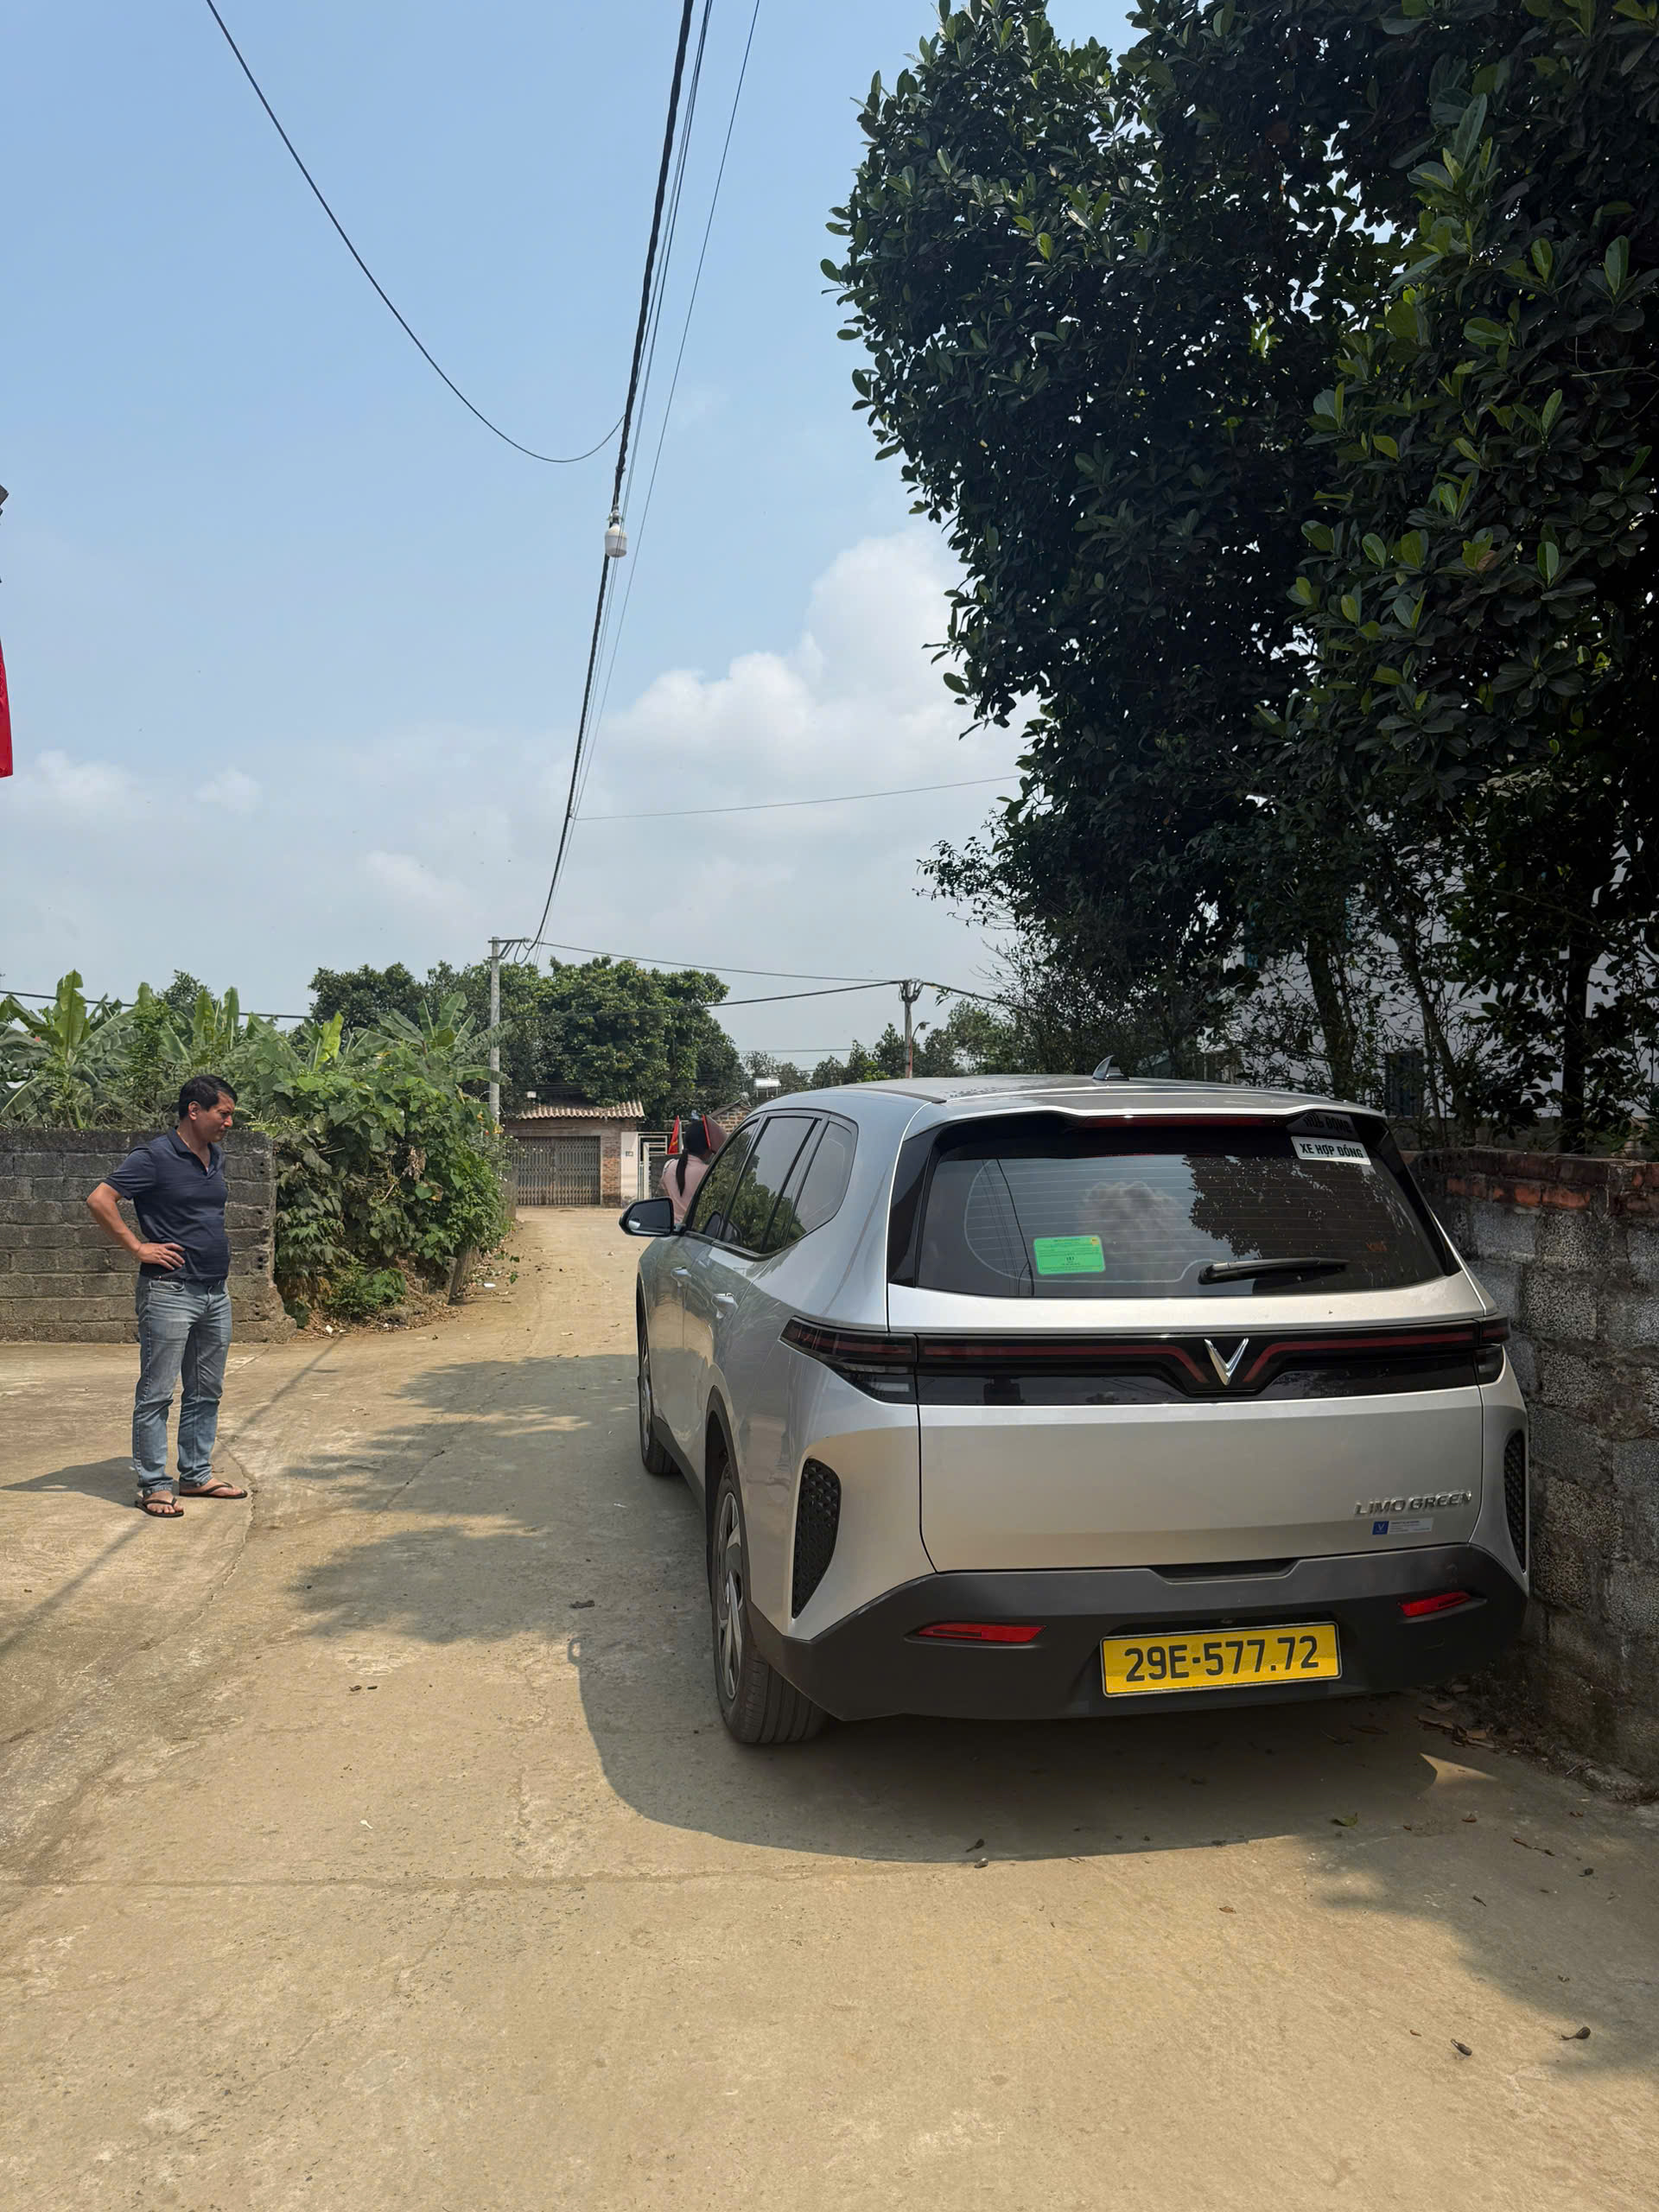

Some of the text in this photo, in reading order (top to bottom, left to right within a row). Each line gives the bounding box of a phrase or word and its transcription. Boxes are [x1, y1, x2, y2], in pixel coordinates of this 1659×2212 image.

[1300, 1143, 1314, 1154] XE
[1314, 1143, 1335, 1157] HỢP
[1355, 1490, 1472, 1515] LIMO GREEN
[1124, 1636, 1319, 1682] 29E-577.72
